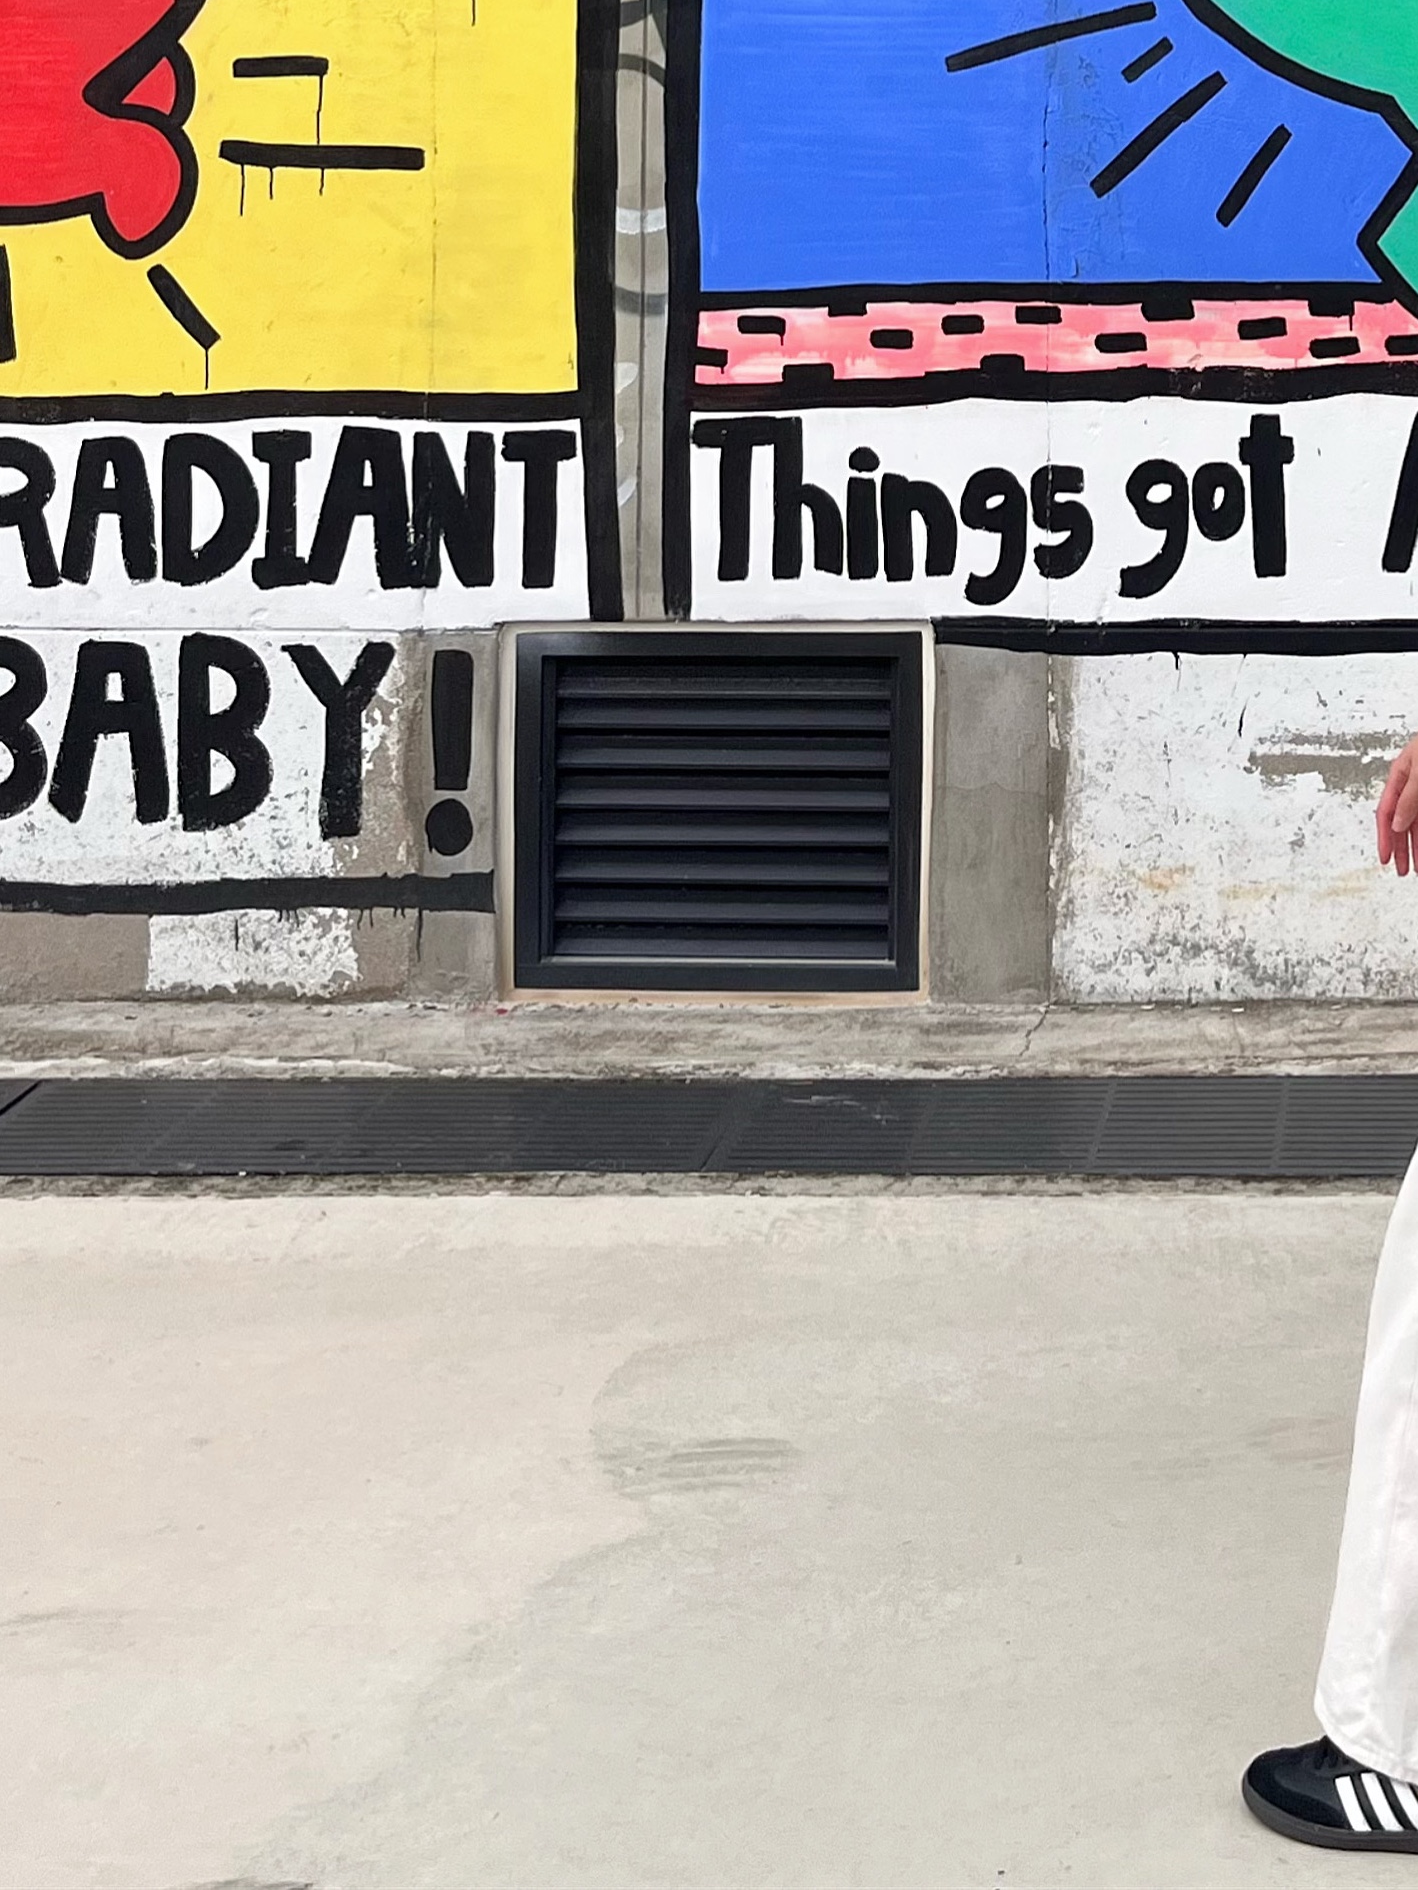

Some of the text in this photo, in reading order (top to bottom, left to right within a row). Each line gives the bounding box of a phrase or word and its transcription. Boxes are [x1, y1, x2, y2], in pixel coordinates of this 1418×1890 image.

[0, 426, 577, 590] RADIANT
[691, 416, 1094, 606] Things
[1118, 413, 1294, 599] got
